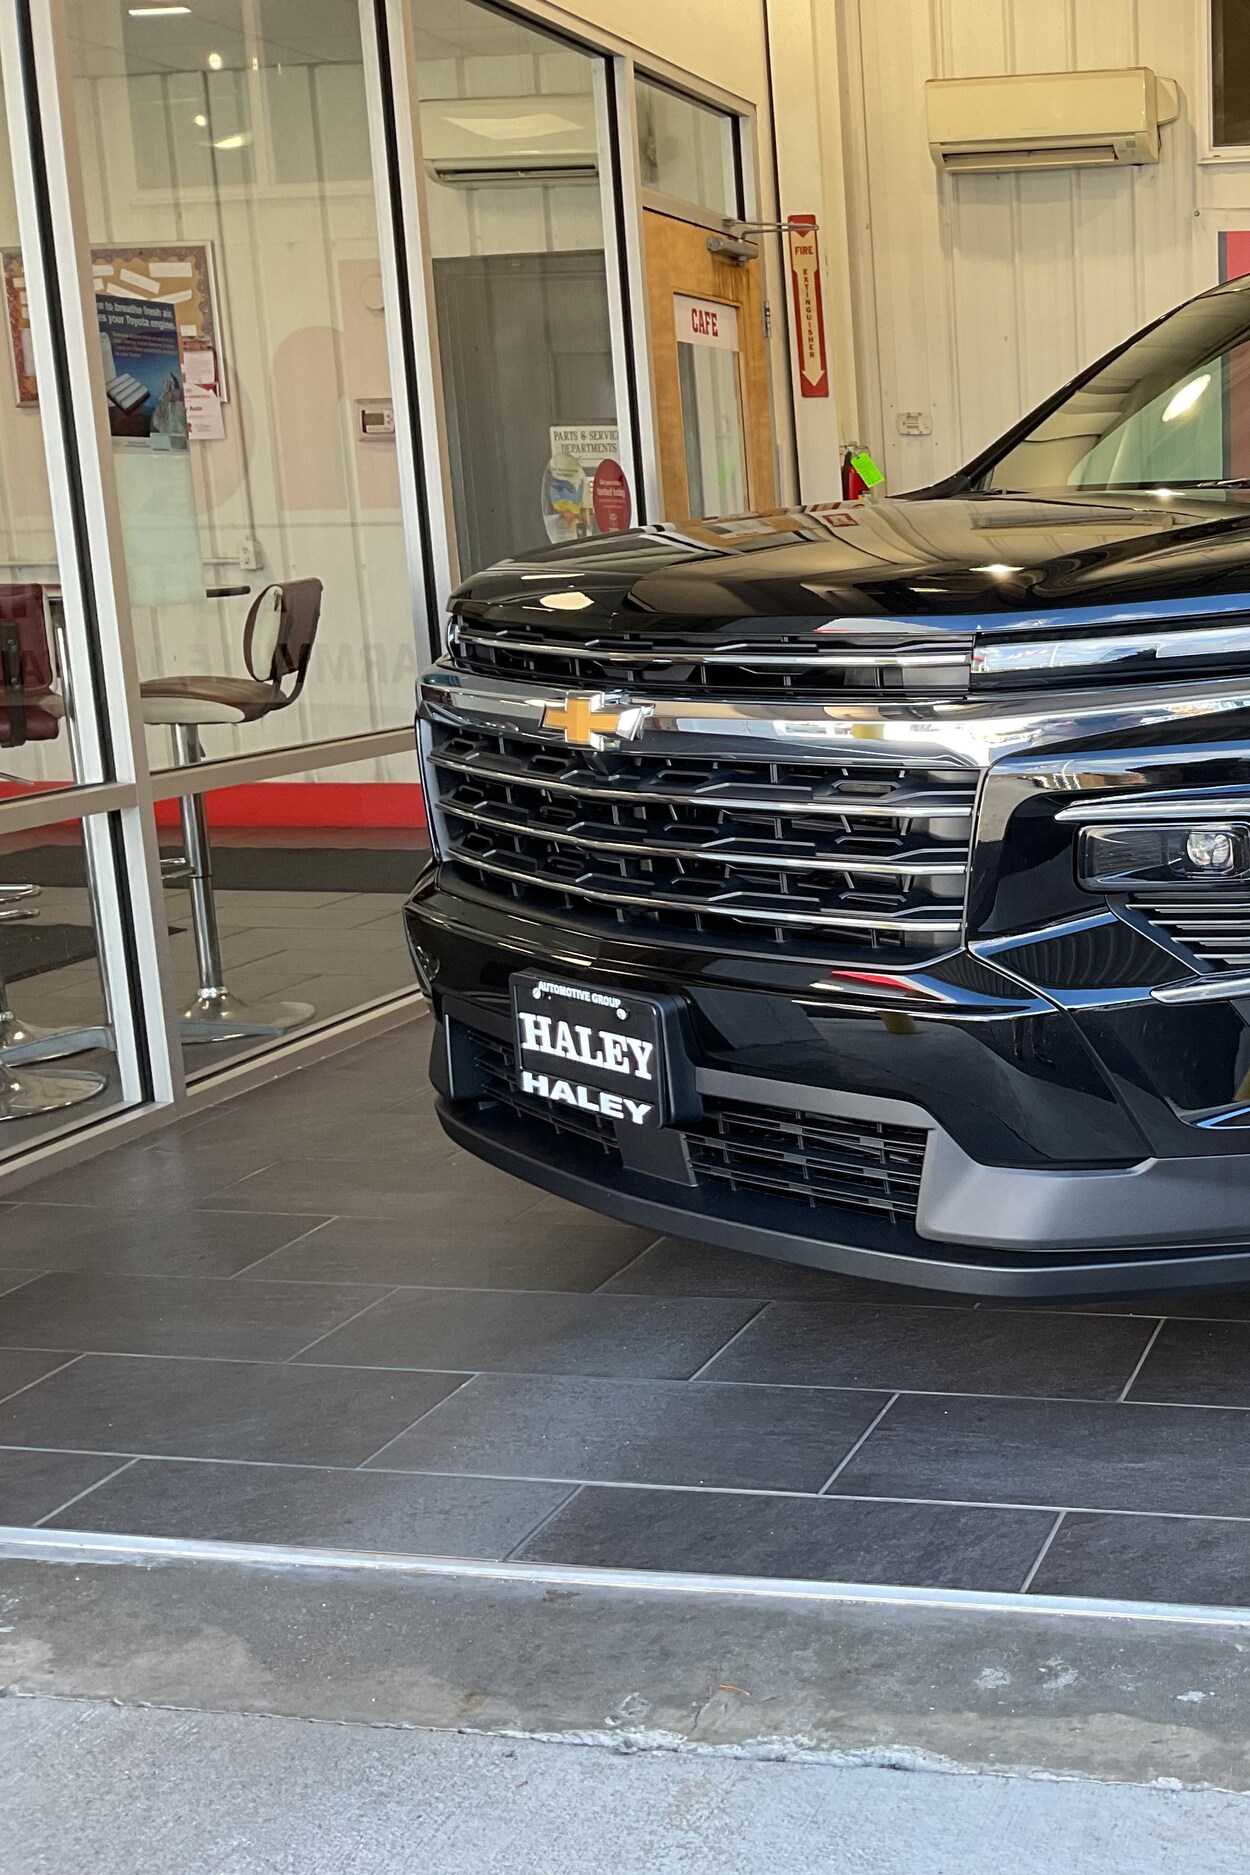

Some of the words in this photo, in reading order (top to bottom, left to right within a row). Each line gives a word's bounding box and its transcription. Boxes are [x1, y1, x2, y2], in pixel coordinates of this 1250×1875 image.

[794, 246, 814, 255] FIRE
[105, 301, 113, 312] to
[114, 302, 142, 315] breathe
[143, 306, 161, 316] fresh
[802, 268, 815, 358] EXTINGUISHER
[108, 314, 124, 325] your
[125, 315, 150, 328] Toyota
[691, 308, 719, 337] CAFE
[553, 431, 578, 441] PARTS
[580, 431, 587, 440] &
[589, 430, 619, 441] SERVIC
[561, 443, 618, 453] DEPARTMENTS
[538, 980, 590, 1002] AUTOMOTIVE
[591, 993, 622, 1009] GROUP
[518, 1012, 653, 1080] HALEY
[521, 1070, 652, 1125] HALEY
